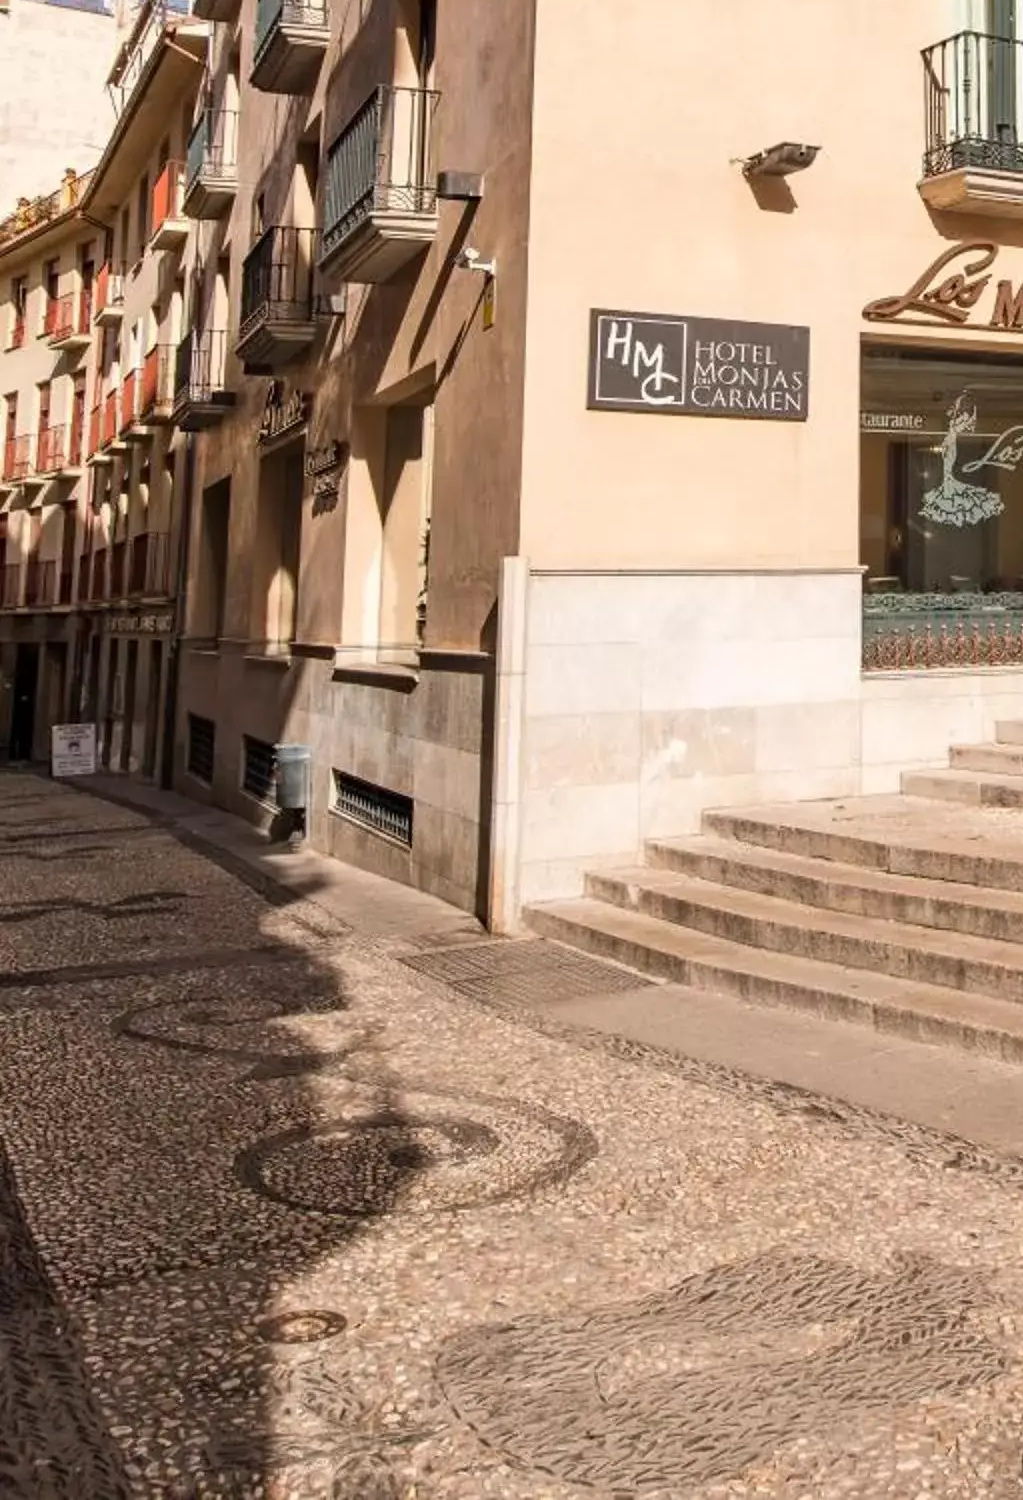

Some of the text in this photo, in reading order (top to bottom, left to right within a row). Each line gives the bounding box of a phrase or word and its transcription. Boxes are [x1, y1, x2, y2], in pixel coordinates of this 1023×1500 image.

[862, 239, 999, 322] Los
[695, 340, 777, 365] HOTEL
[692, 362, 803, 391] MONJAS
[691, 386, 802, 411] CARMEN
